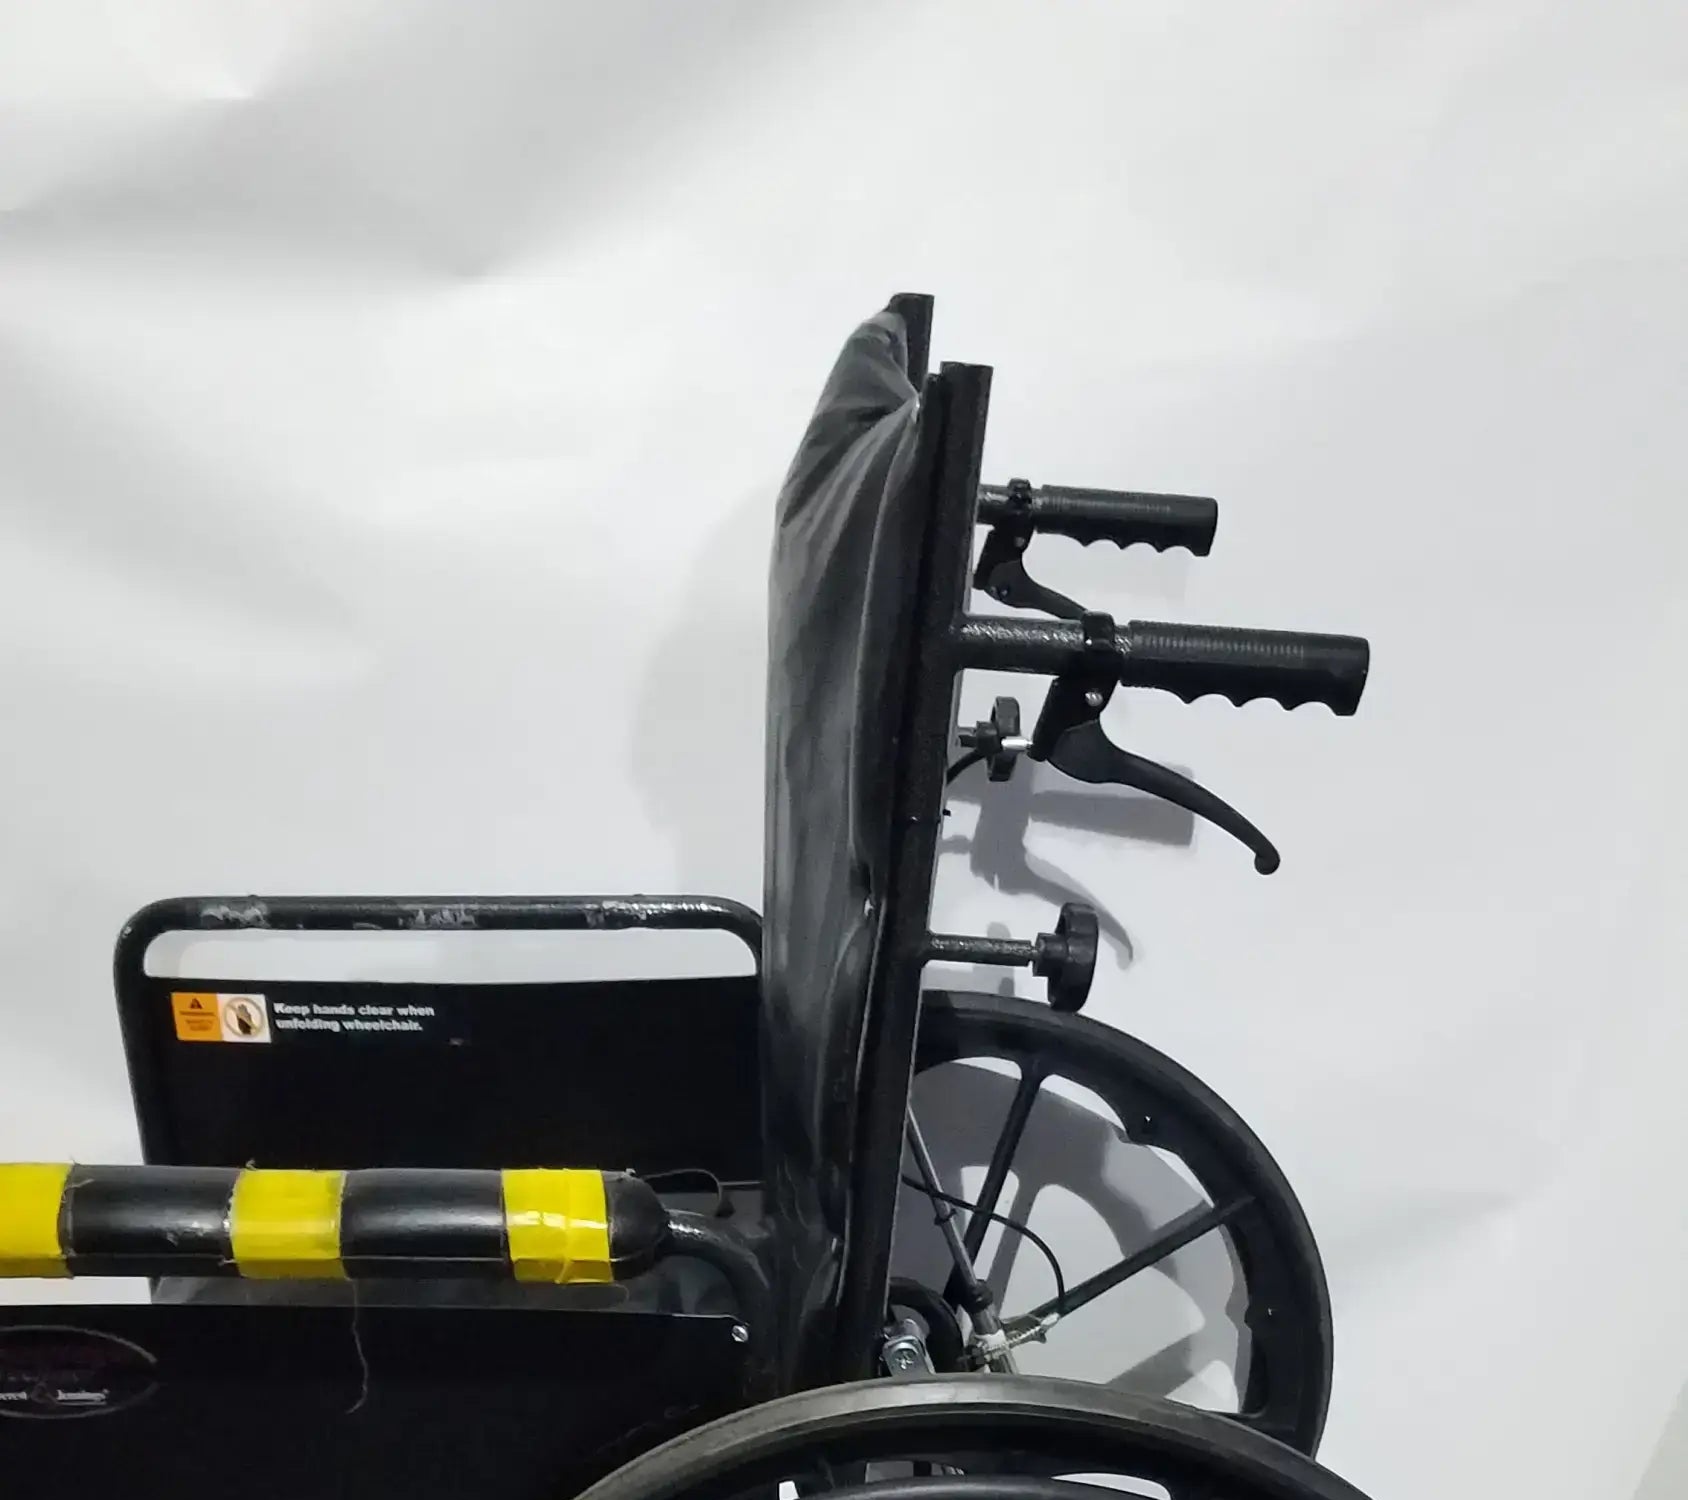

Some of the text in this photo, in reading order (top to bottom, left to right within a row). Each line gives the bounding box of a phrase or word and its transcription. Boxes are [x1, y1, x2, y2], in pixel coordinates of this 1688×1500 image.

[273, 1003, 435, 1016] Keep hands clear when
[275, 1018, 424, 1032] unfolding wheelchair.
